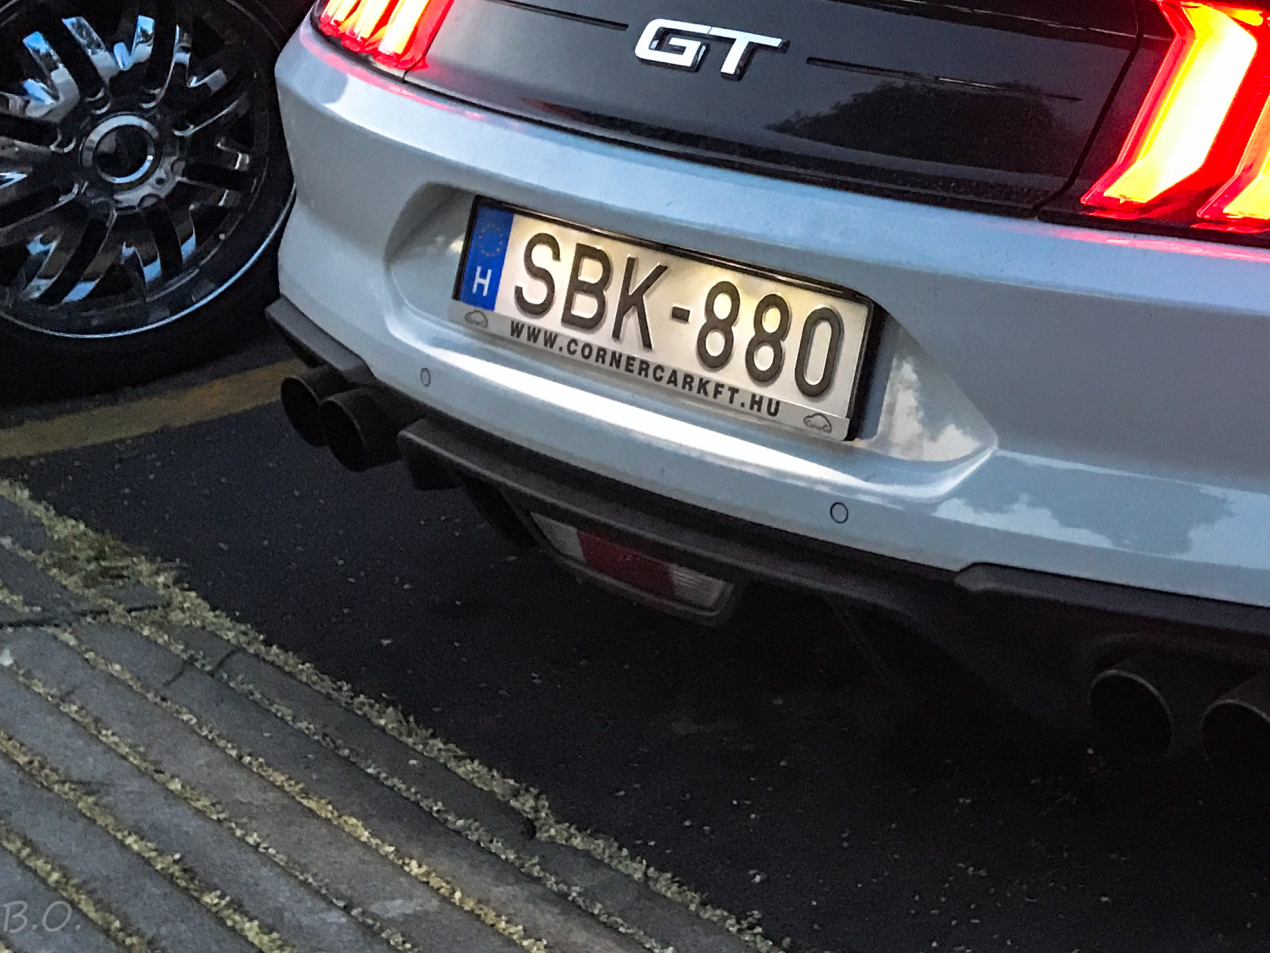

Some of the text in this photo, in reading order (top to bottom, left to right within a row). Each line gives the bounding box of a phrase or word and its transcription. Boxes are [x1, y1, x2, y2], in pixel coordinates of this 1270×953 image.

[634, 18, 787, 79] GT
[472, 266, 492, 297] H
[513, 232, 845, 398] SBK-880
[508, 319, 781, 418] WWW.CORNERCARKFT.HU
